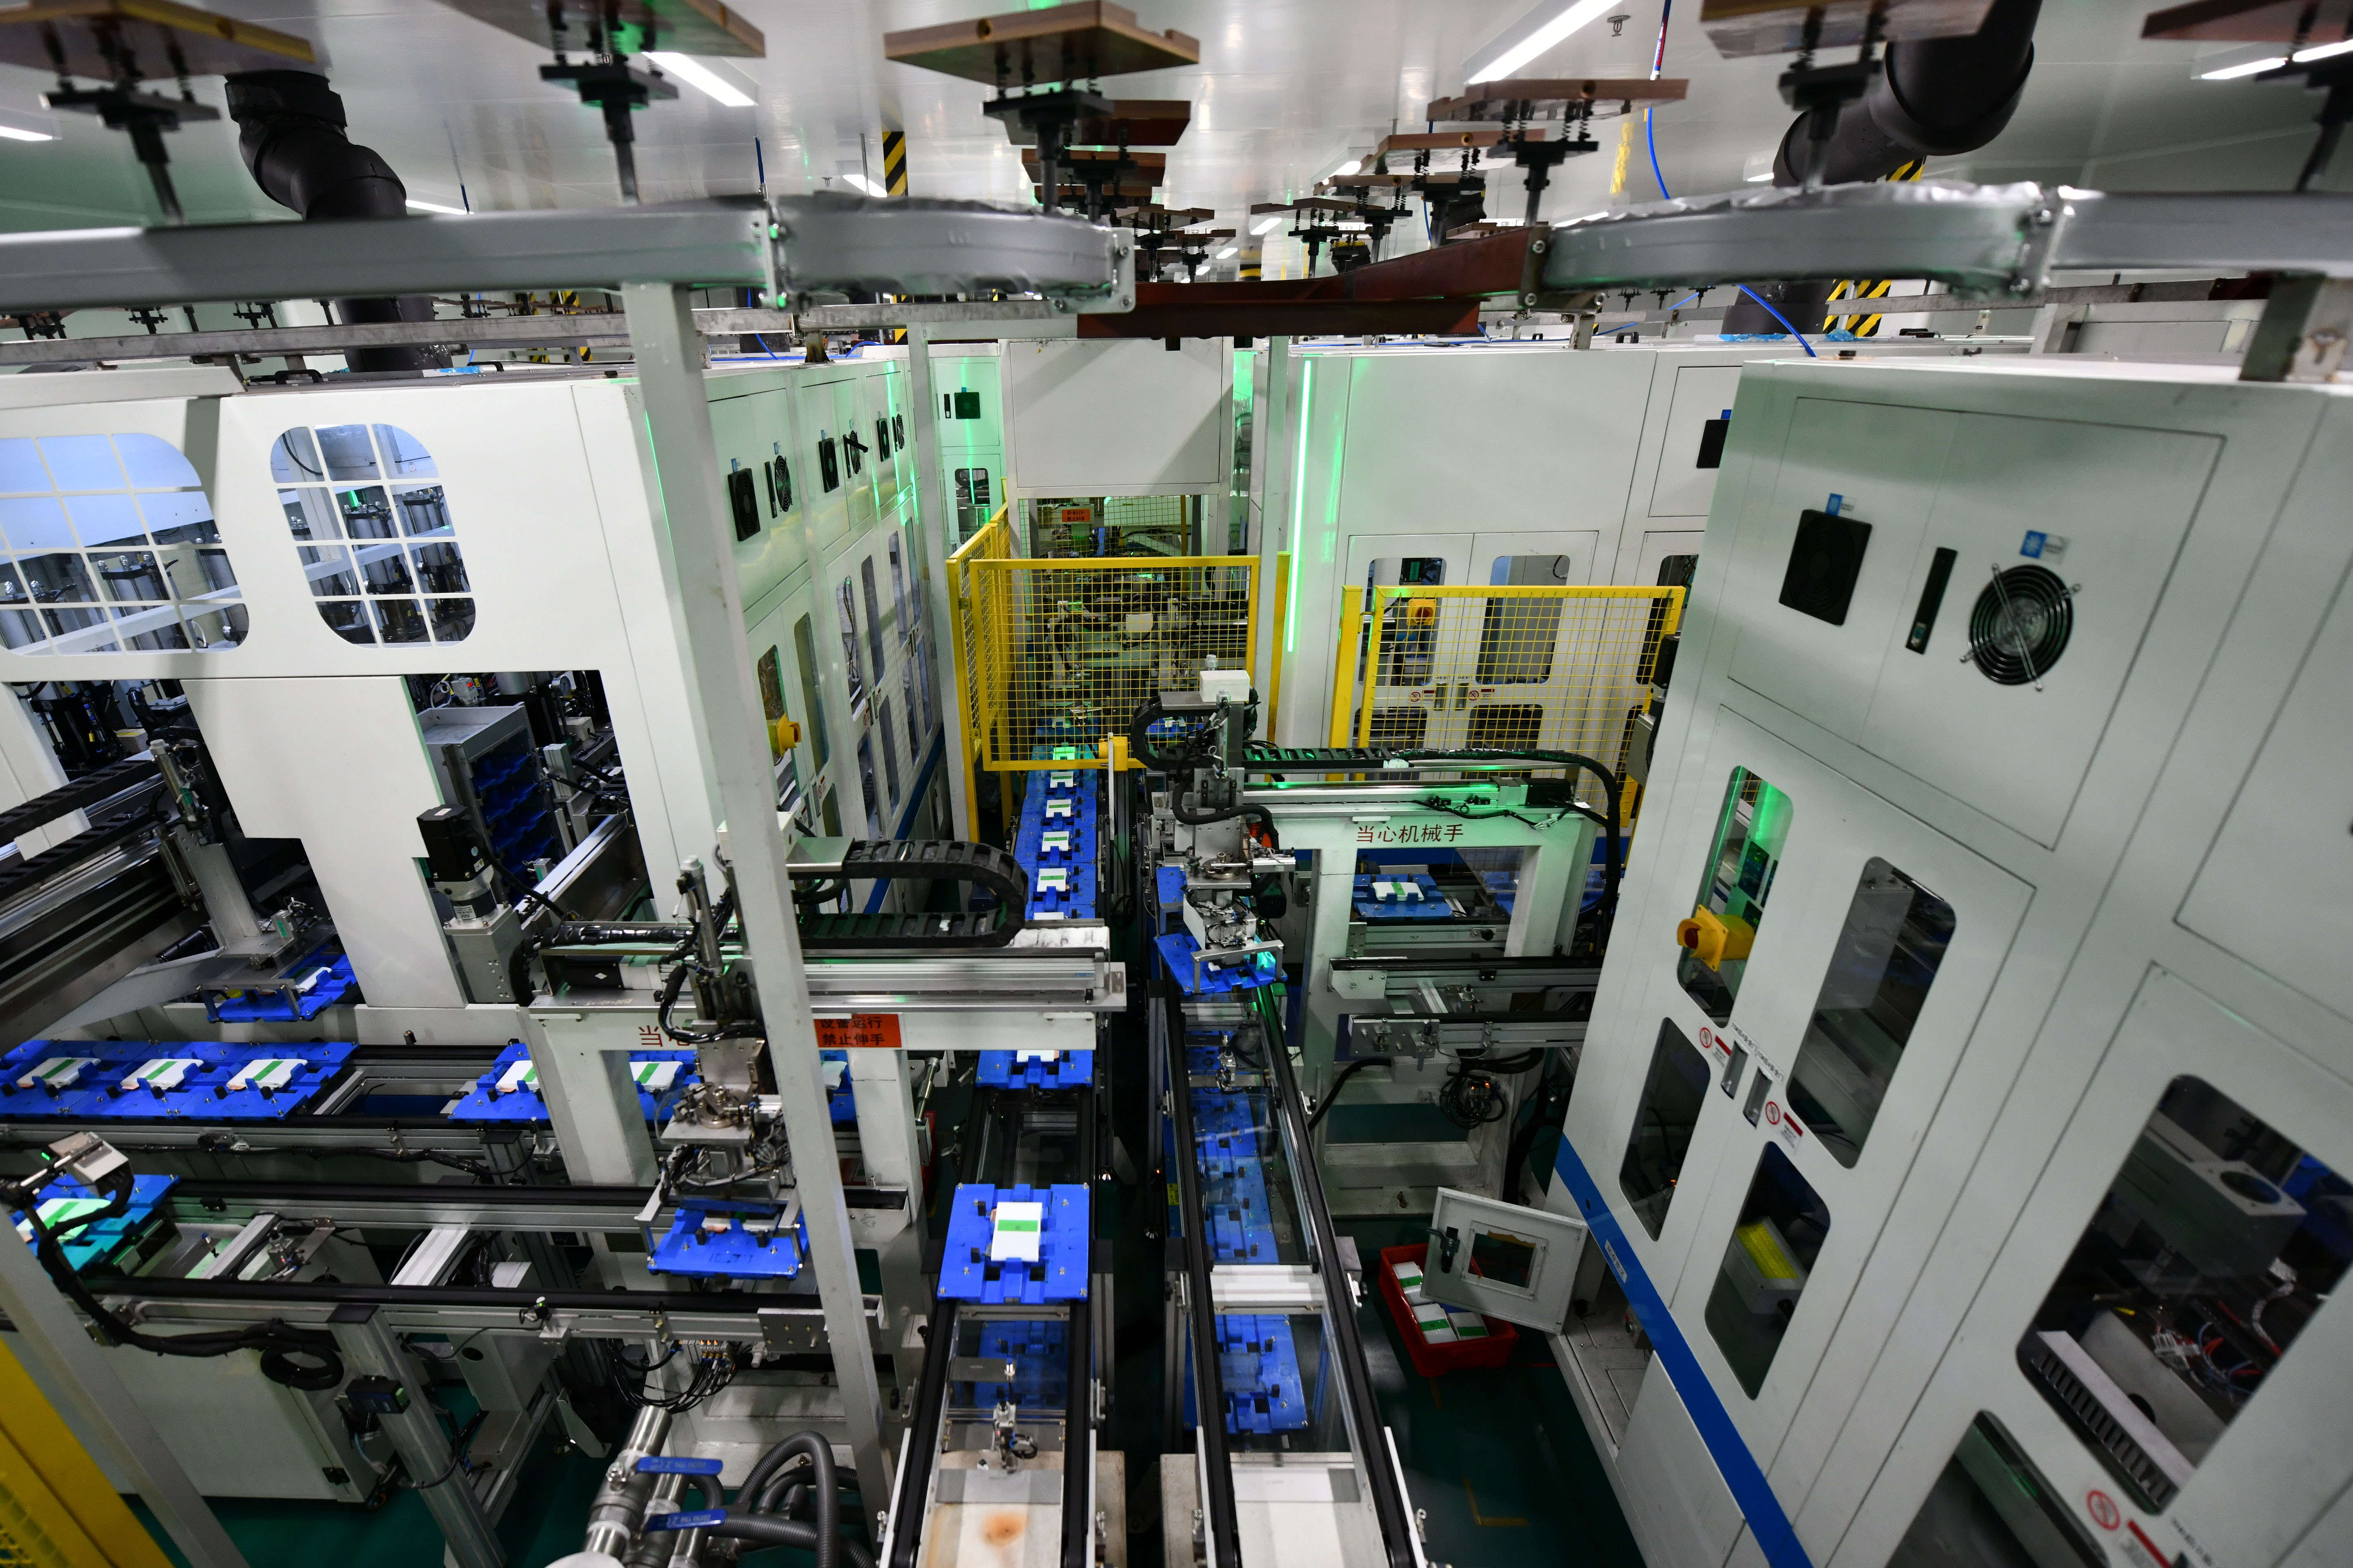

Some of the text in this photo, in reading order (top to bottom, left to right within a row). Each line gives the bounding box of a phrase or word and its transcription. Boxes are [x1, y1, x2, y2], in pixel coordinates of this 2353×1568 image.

[1357, 824, 1464, 843] 当心机械手
[819, 1016, 882, 1029] 设备运行
[823, 1033, 885, 1045] 禁止伸手
